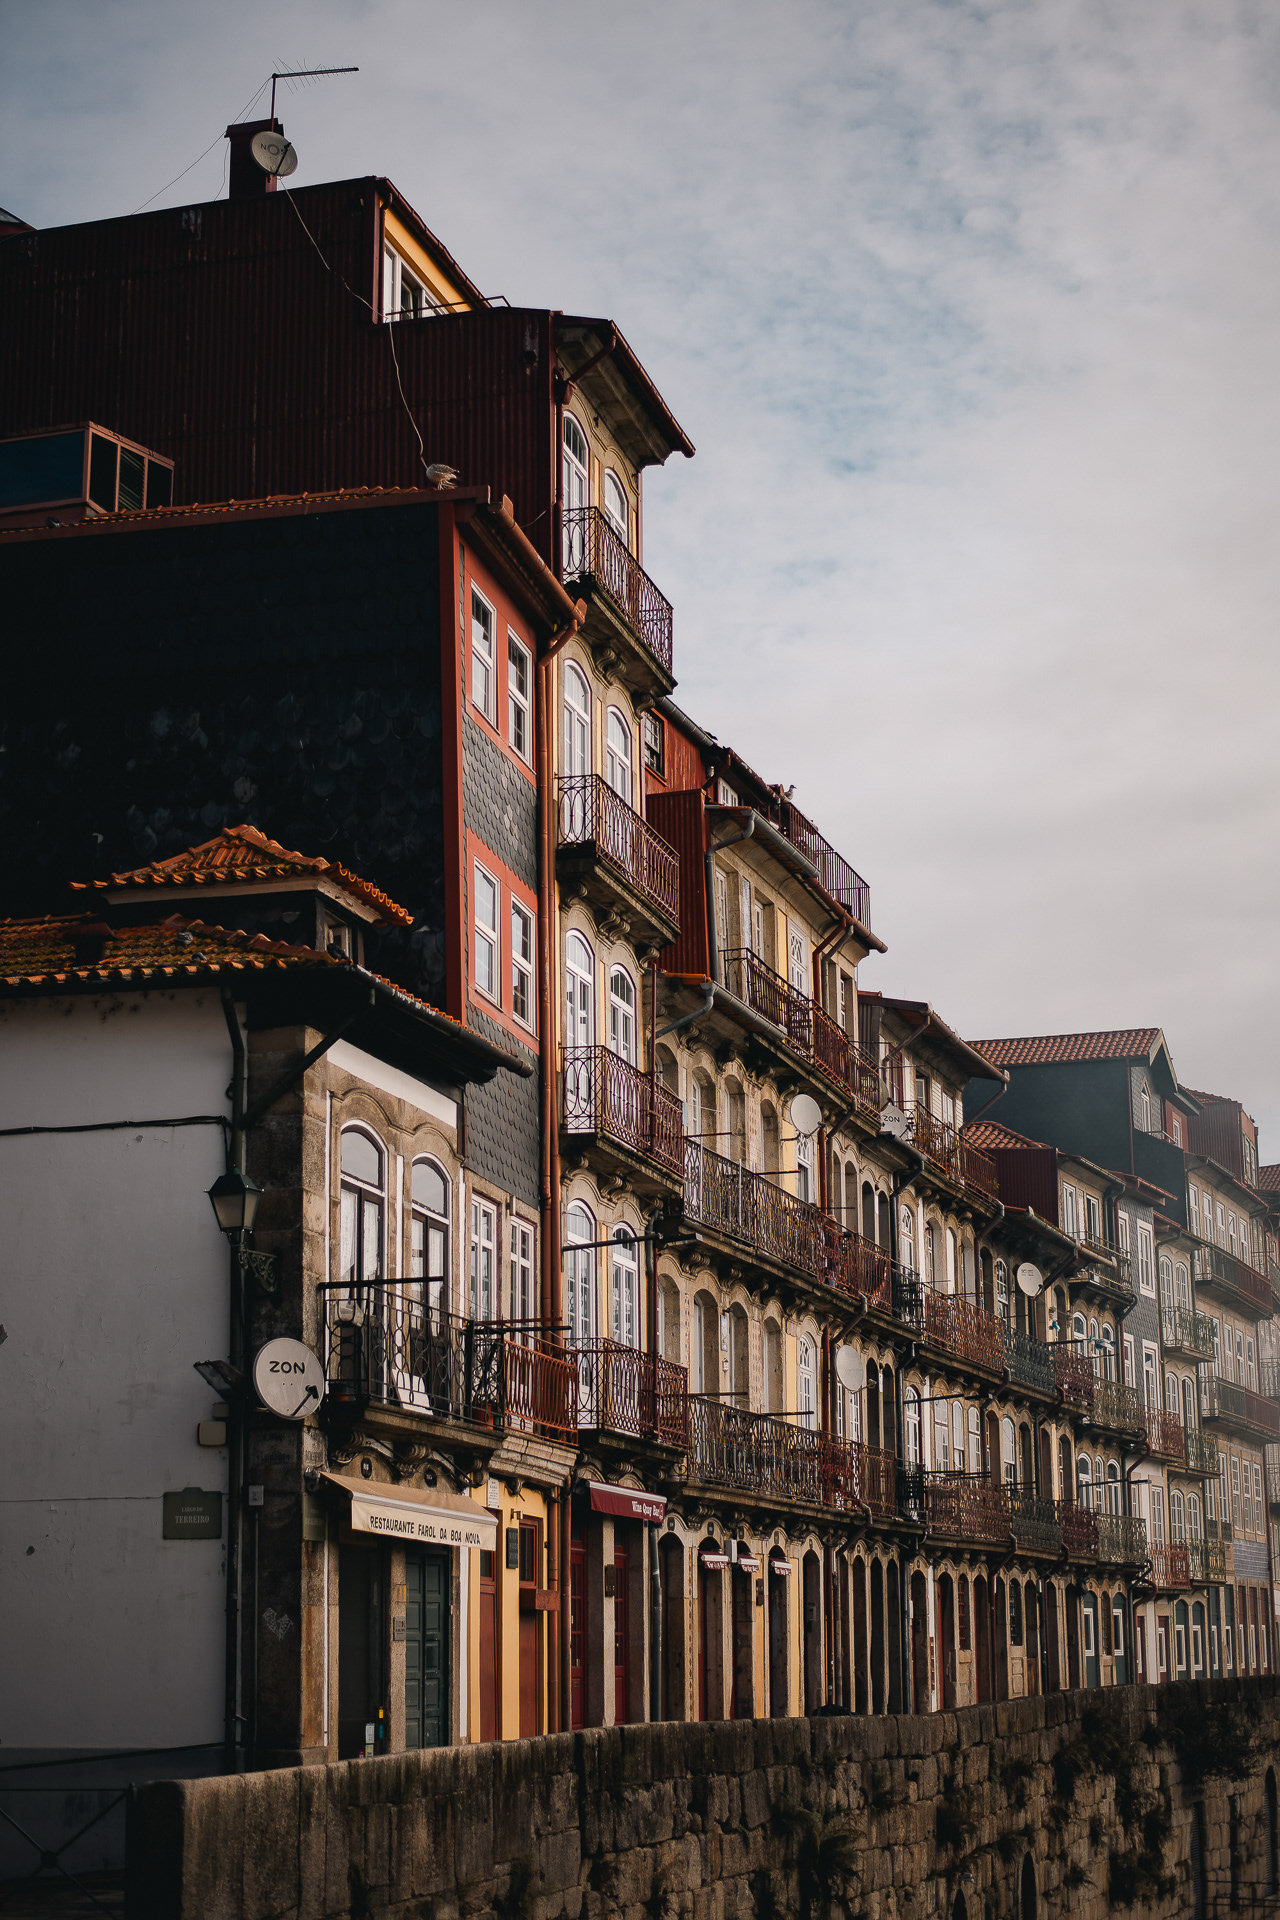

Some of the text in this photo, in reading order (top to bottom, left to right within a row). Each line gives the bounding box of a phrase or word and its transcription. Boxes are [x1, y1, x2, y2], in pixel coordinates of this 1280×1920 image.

[269, 1361, 305, 1374] ZON
[632, 1501, 660, 1517] Wine Quay Bar
[174, 1515, 210, 1524] TERREIRO
[370, 1515, 481, 1545] RESTAURANTE FAROL DA BOA NOVA
